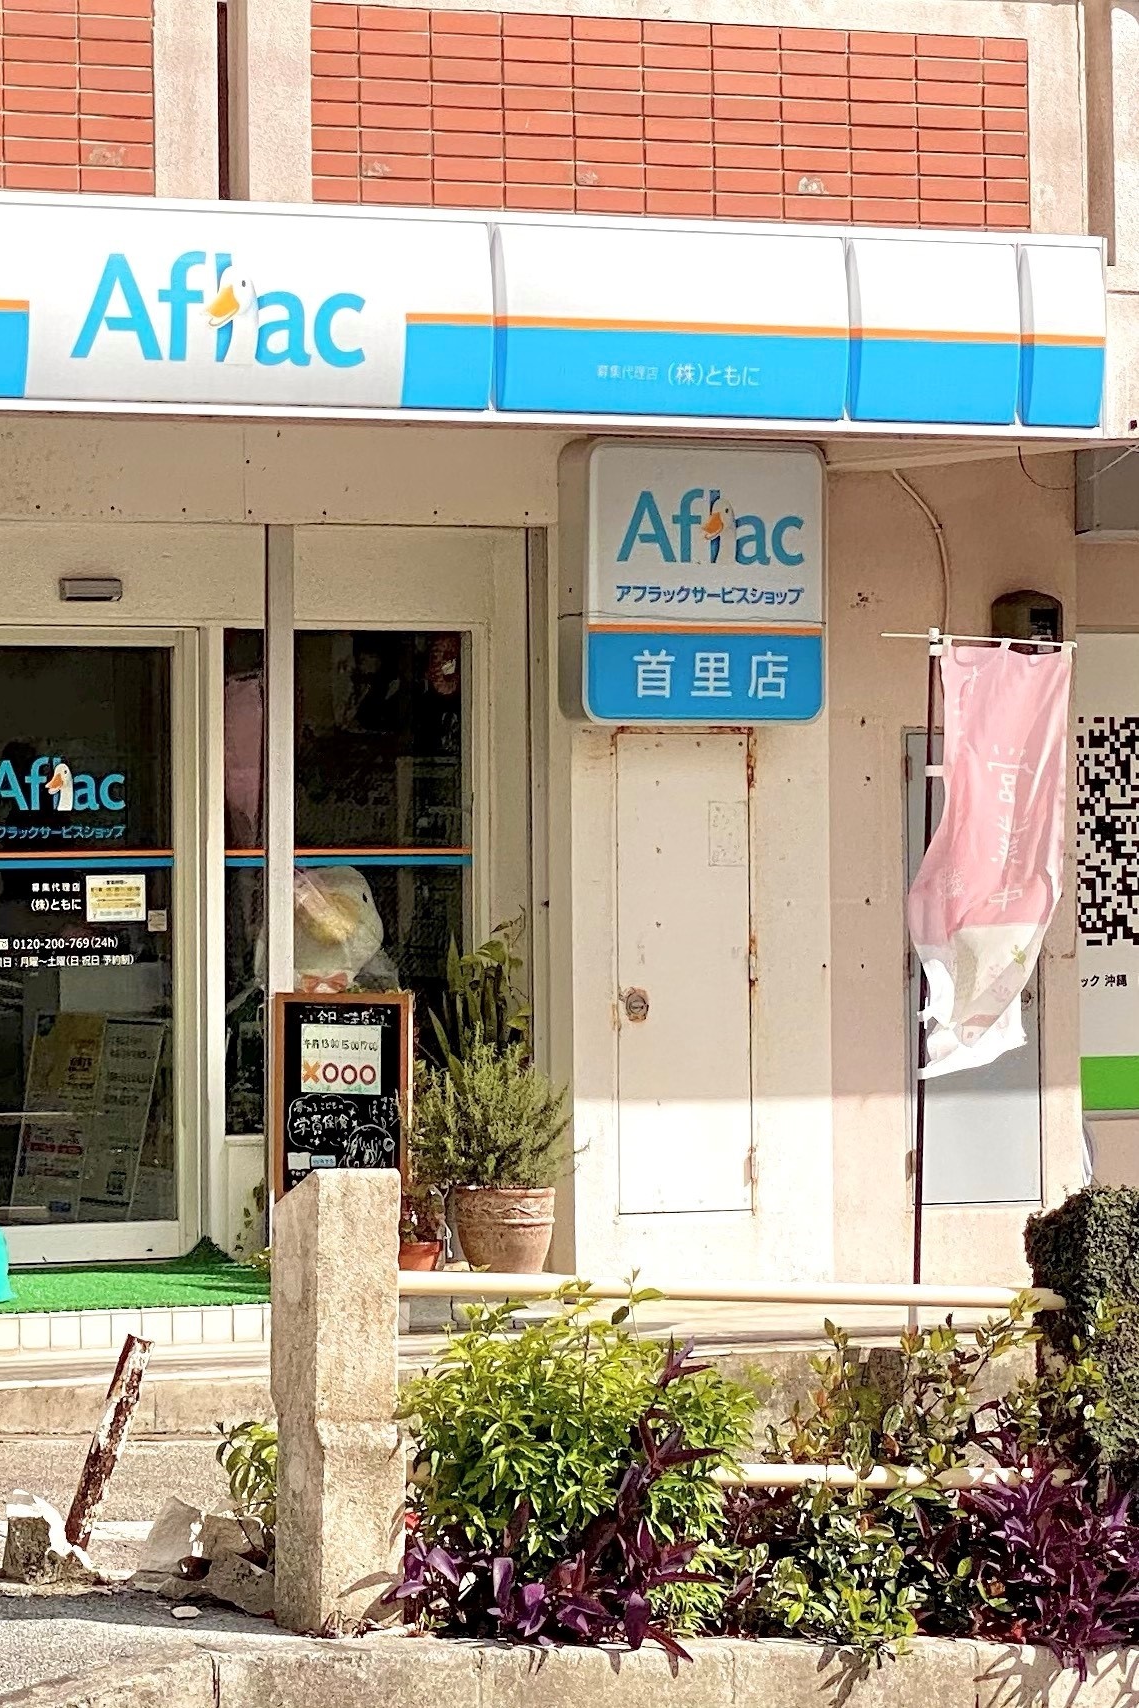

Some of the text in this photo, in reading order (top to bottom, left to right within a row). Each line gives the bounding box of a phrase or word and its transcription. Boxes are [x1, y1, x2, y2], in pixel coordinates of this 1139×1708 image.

[69, 250, 366, 368] Aflac
[615, 584, 805, 606] アフラックサービスショップ
[632, 648, 789, 700] 首里店
